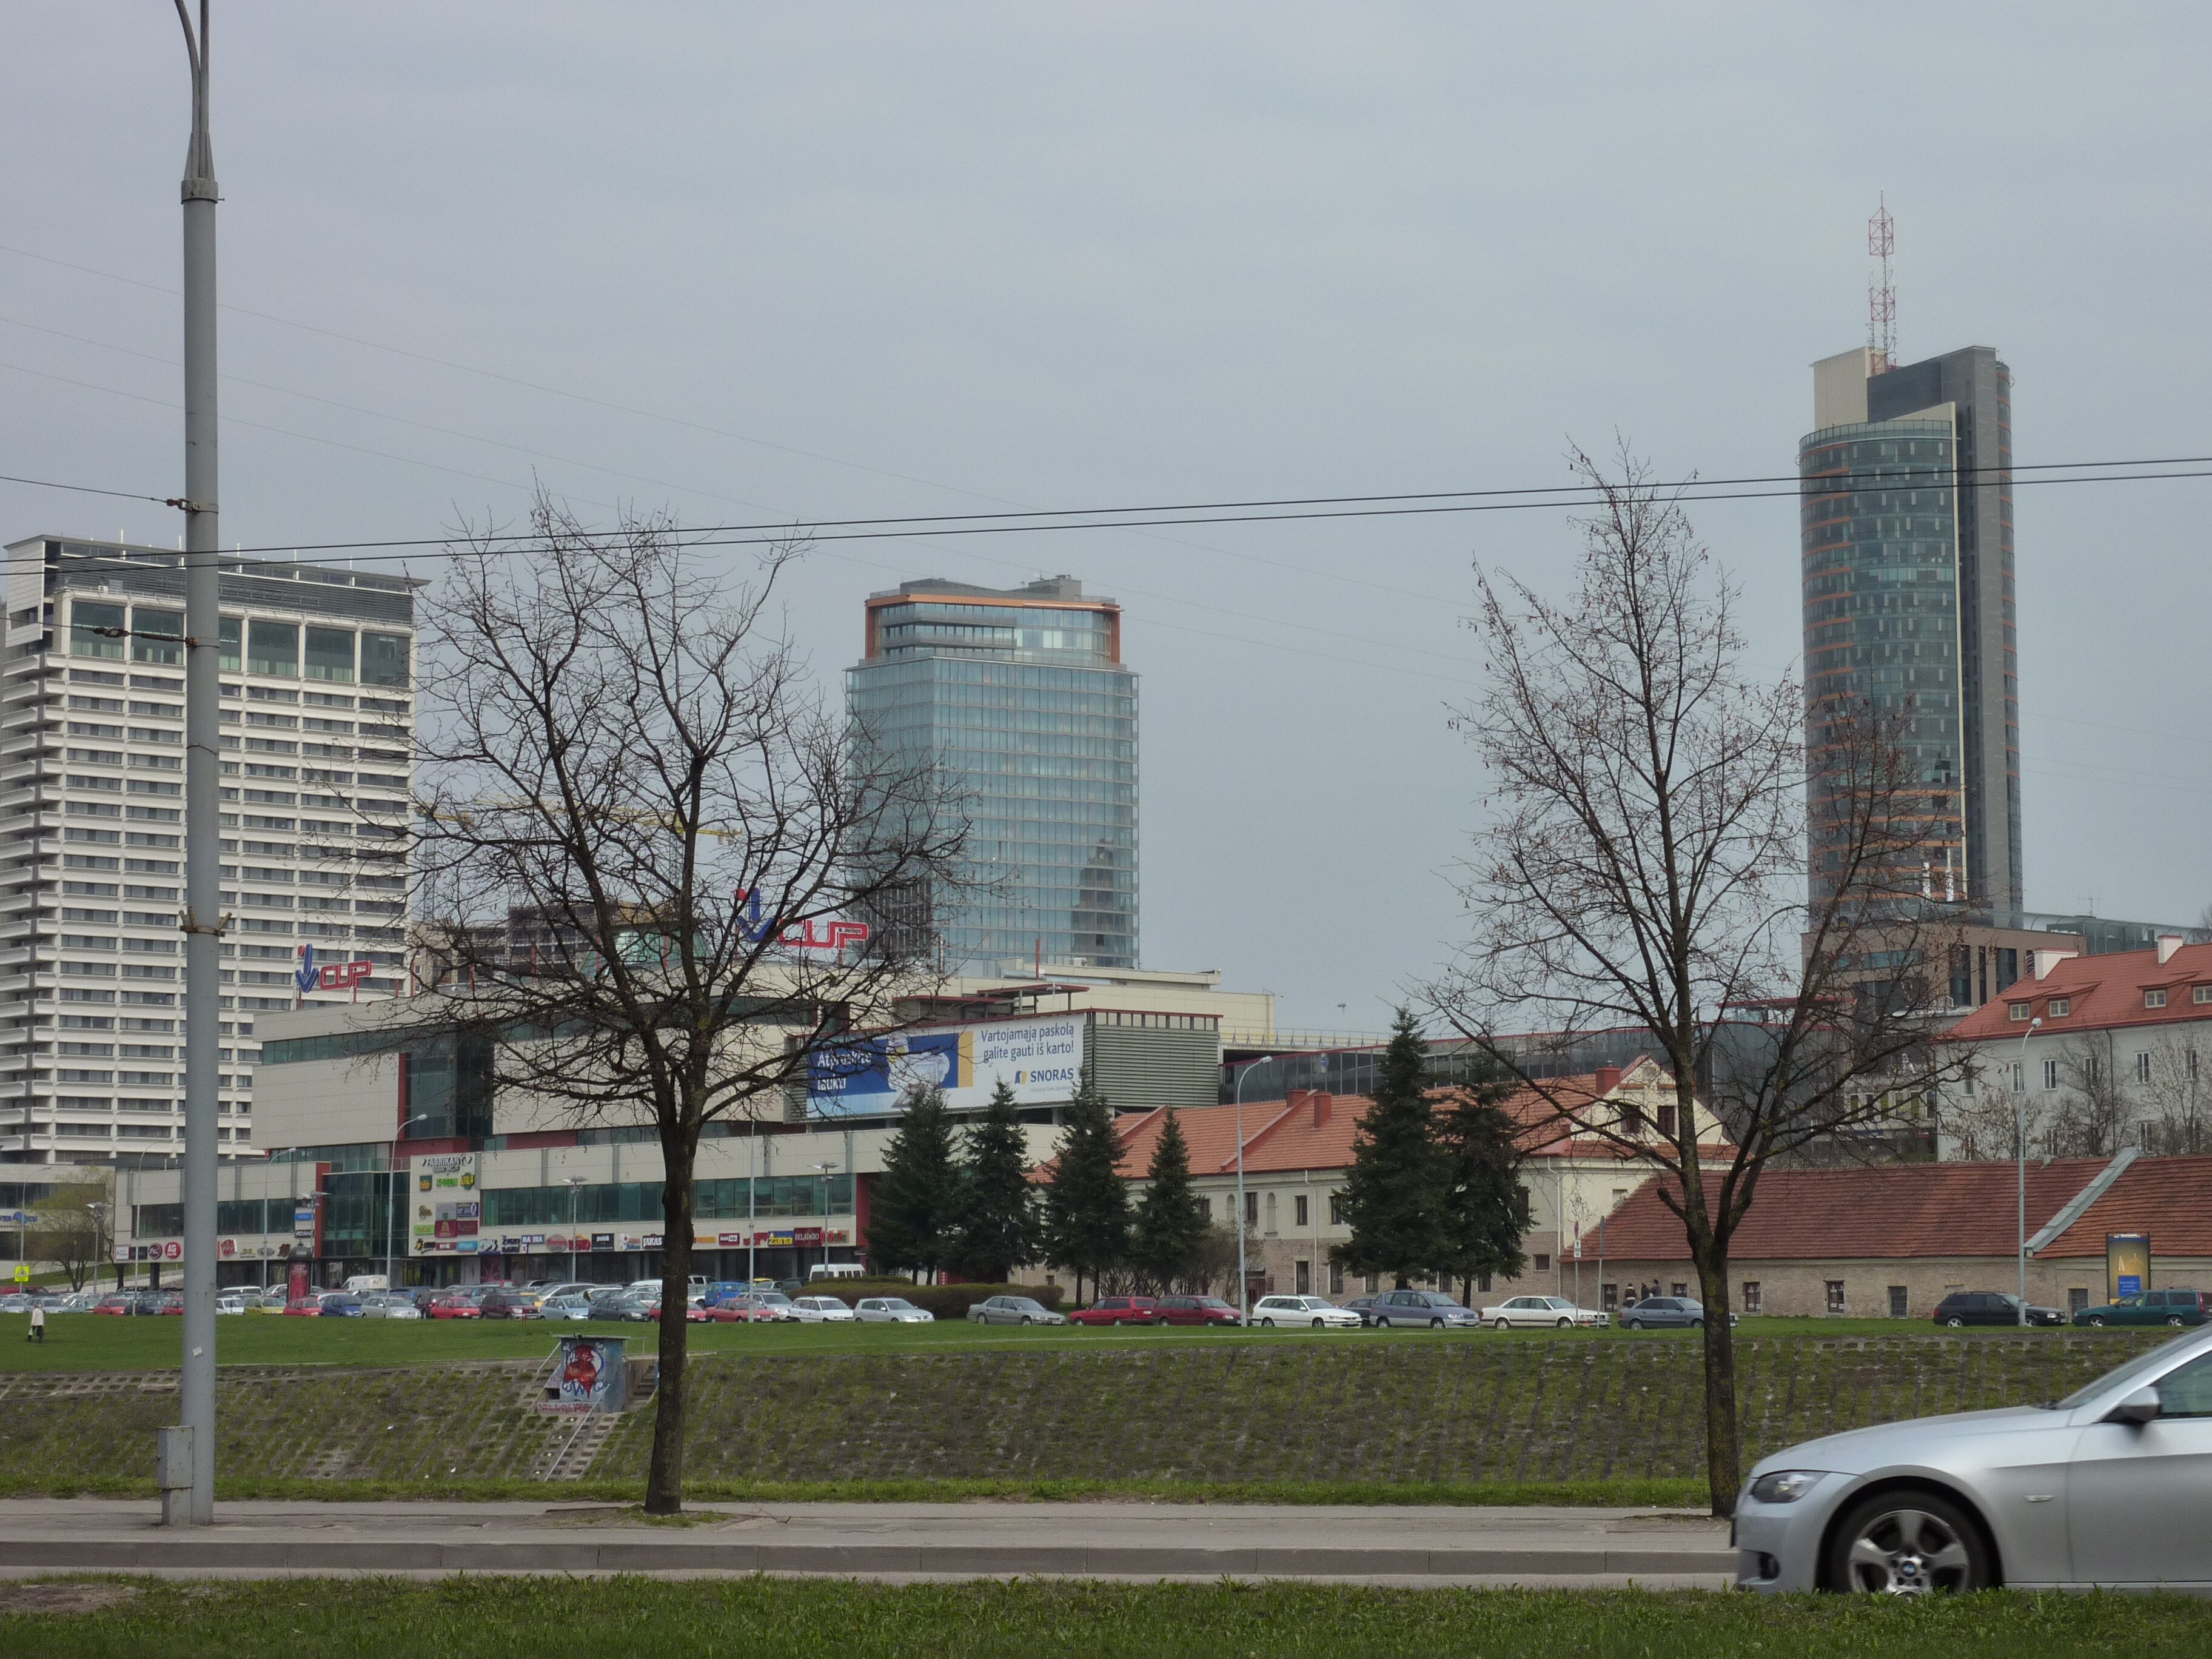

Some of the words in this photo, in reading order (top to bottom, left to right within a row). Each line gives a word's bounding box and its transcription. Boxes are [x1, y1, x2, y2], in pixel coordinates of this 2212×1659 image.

[777, 917, 869, 950] CUP
[319, 960, 372, 990] CUP
[981, 1026, 1037, 1045] Vartojamąją
[1039, 1022, 1074, 1041] paskolą
[984, 1046, 1008, 1063] galite
[1011, 1042, 1034, 1061] gauti
[1037, 1043, 1044, 1056] iš
[1047, 1041, 1074, 1054] karto!
[1030, 1068, 1074, 1082] SNORAS
